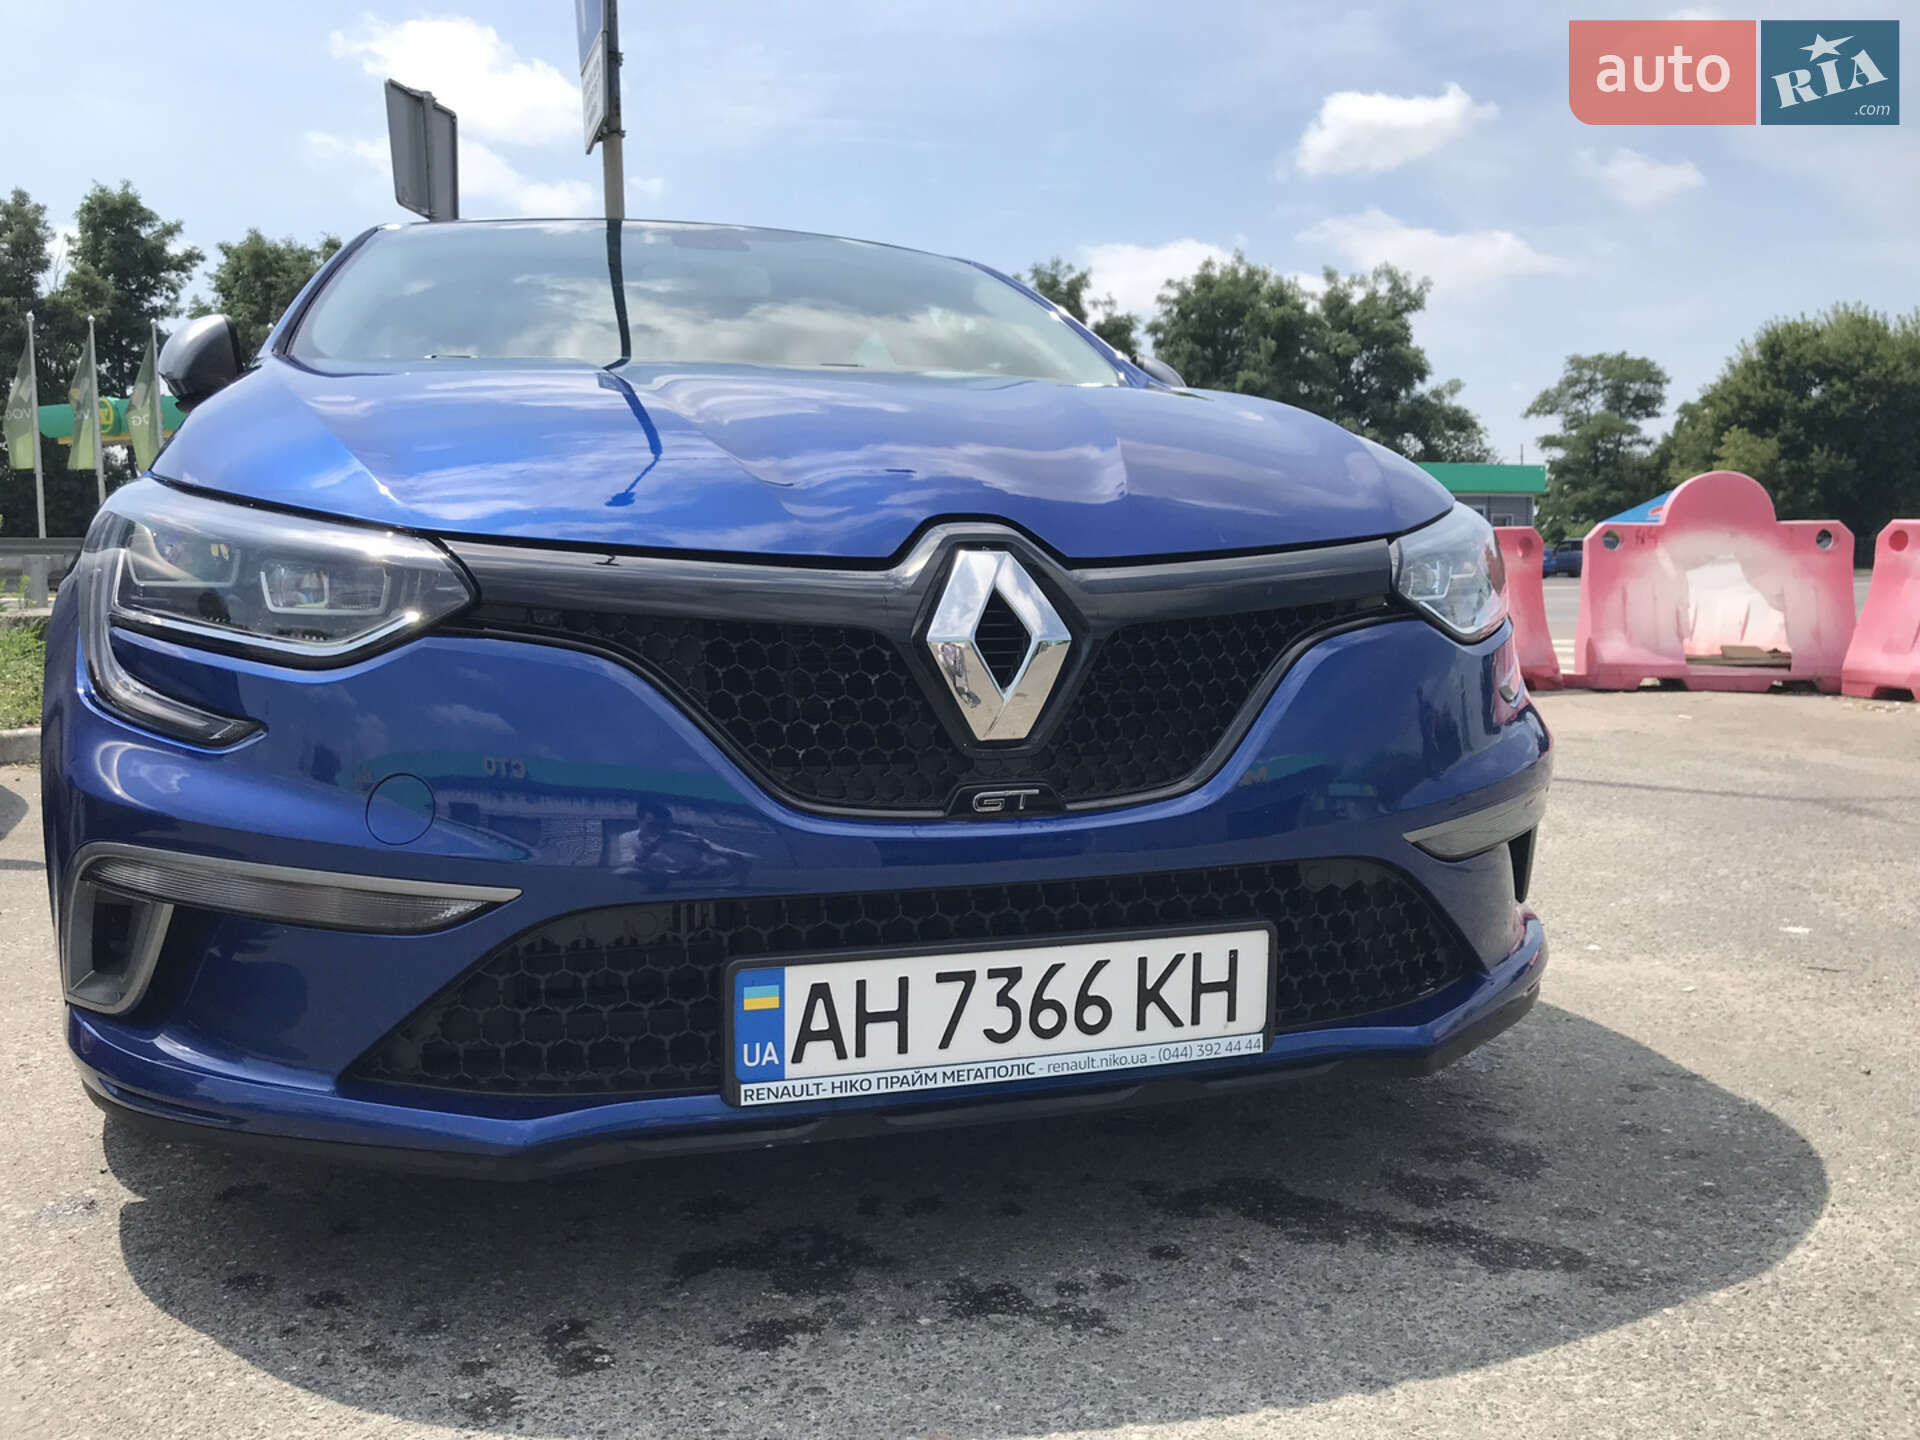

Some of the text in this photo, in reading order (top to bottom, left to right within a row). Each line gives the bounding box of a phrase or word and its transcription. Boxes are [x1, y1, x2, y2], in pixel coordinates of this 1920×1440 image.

[972, 788, 1040, 813] GT
[791, 949, 1239, 1065] AH 7366 KH
[743, 1041, 780, 1067] UA
[831, 1078, 872, 1095] НІКО
[876, 1071, 938, 1090] ПРАЙМ
[941, 1062, 1036, 1085] МЕГАПОЛІС
[1047, 1052, 1148, 1073] renault.niko.ua
[1159, 1045, 1193, 1062] (044)
[1196, 1042, 1222, 1057] 392
[1224, 1040, 1242, 1053] 44
[1244, 1038, 1261, 1051] 44
